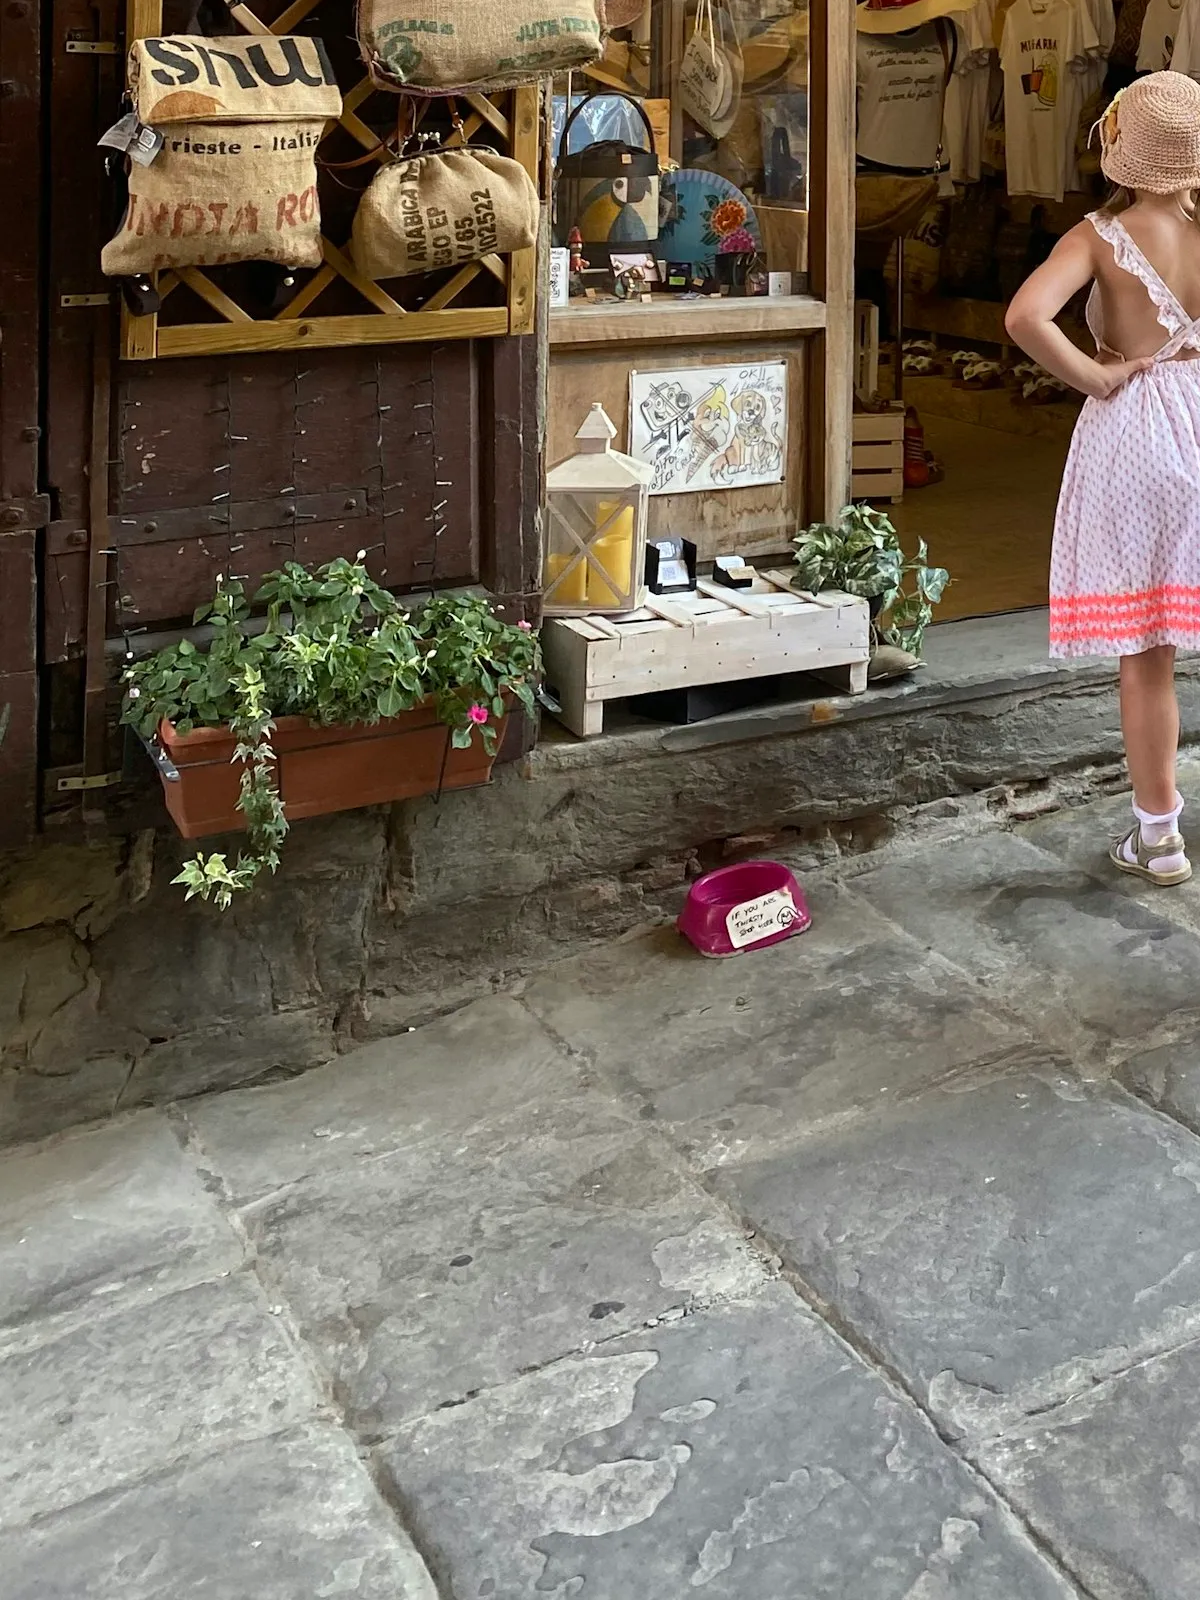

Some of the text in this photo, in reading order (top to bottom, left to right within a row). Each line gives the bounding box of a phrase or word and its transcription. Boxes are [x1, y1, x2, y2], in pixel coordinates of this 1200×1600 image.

[272, 131, 319, 151] Italia
[400, 189, 427, 262] ARABICA
[426, 206, 449, 231] EP
[470, 188, 498, 253] 102522
[731, 910, 741, 921] IF
[743, 904, 759, 916] YOU
